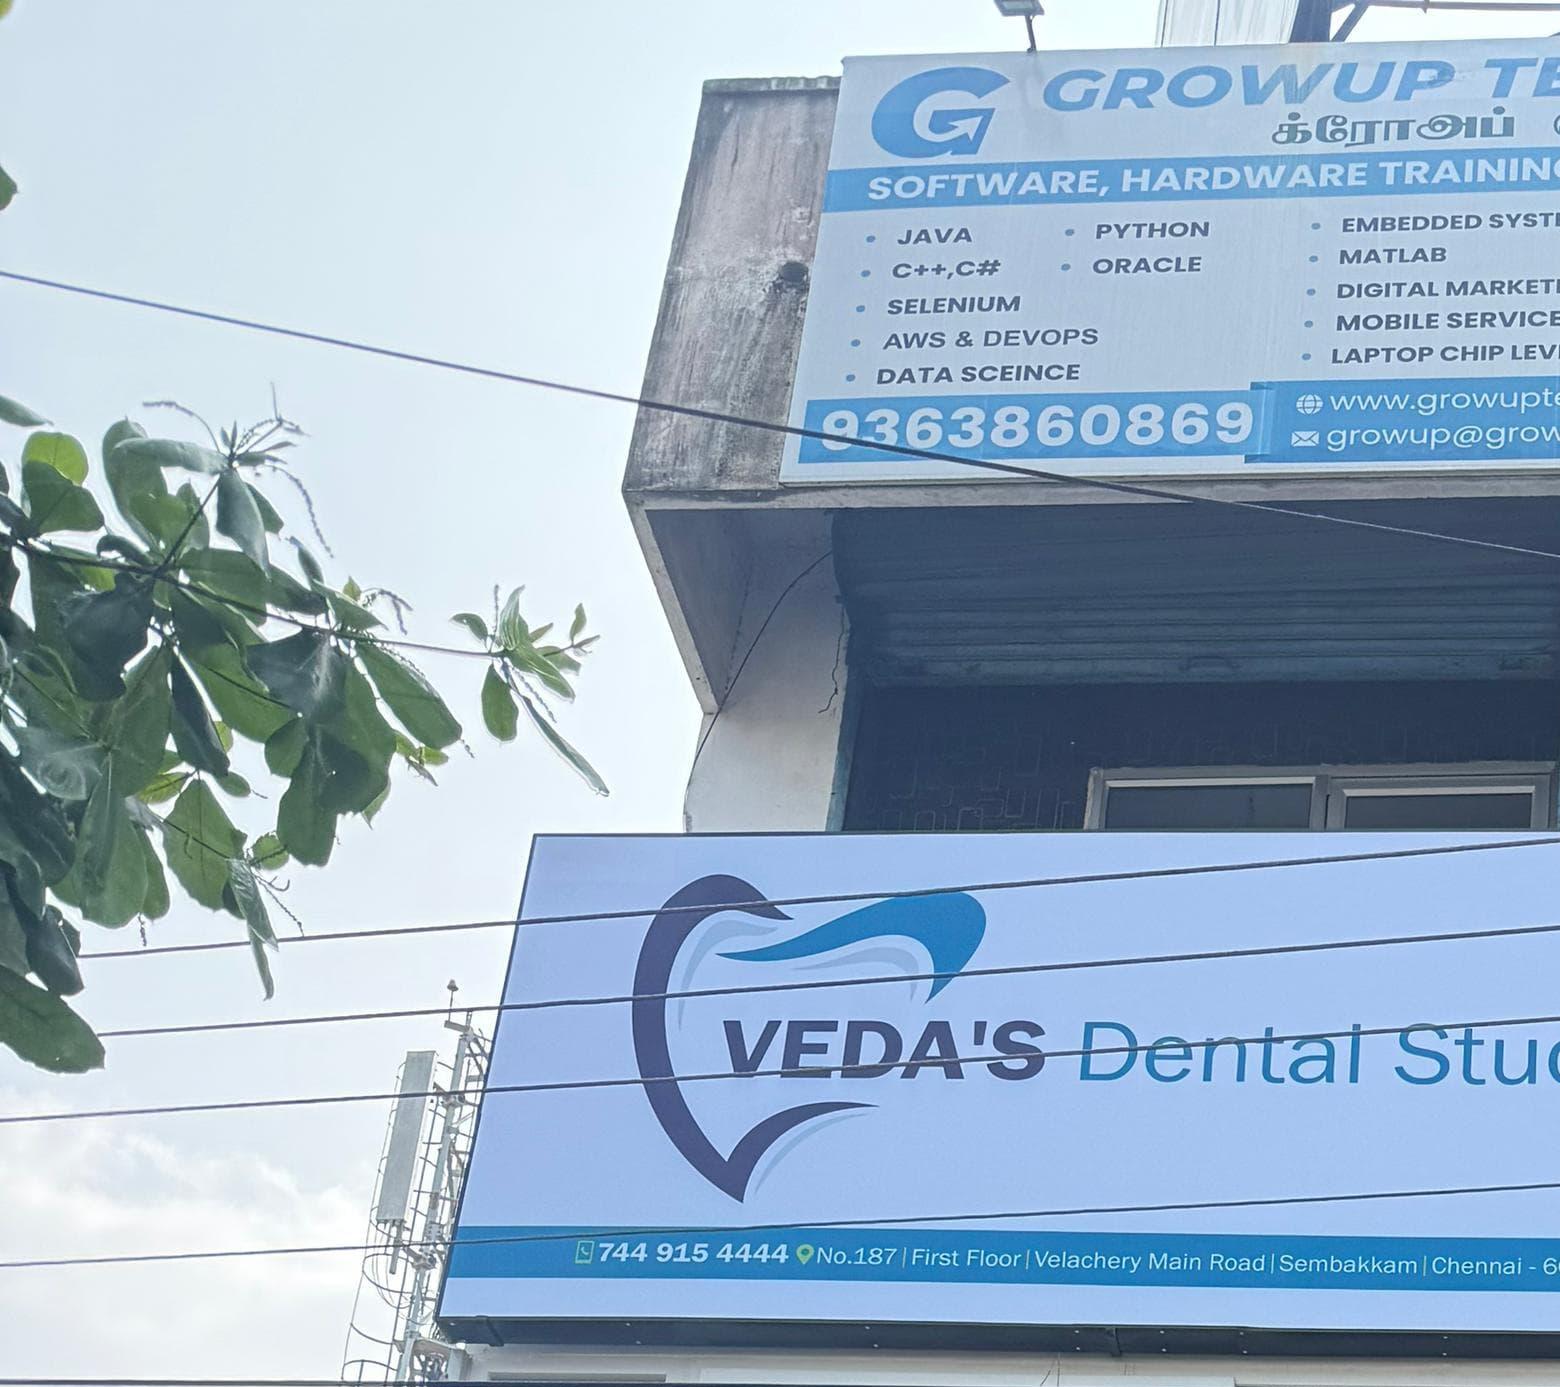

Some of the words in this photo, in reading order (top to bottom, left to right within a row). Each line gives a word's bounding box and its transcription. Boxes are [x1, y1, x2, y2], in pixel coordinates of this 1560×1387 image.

[1043, 59, 1458, 112] GROWUP
[867, 171, 1110, 200] SOFTWARE,
[1121, 163, 1368, 194] HARDWARE
[897, 227, 972, 246] JAVA
[1095, 221, 1210, 240] PYTHON
[1092, 256, 1202, 275] ORACLE
[1339, 247, 1447, 265] MATLAB
[892, 259, 1000, 281] C++,C#
[1336, 282, 1439, 299] DIGITAL
[887, 296, 1021, 316] SELENIUM
[876, 366, 955, 385] DATA
[961, 364, 1080, 382] SCEINCE
[821, 402, 1254, 453] 9363860869
[723, 1020, 1046, 1080] VEDA'S
[1079, 1020, 1361, 1084] Dental
[598, 1243, 648, 1262] 744
[655, 1243, 709, 1263] 915
[716, 1243, 789, 1264] 4444
[816, 1247, 897, 1267] No.187
[911, 1248, 959, 1268] First
[967, 1248, 1021, 1268] Floor
[1035, 1250, 1141, 1273] Velachery
[1148, 1252, 1201, 1272] Main
[1209, 1253, 1265, 1273] Road
[1279, 1254, 1418, 1274] Sembakkam
[1431, 1255, 1523, 1276] Chennai
